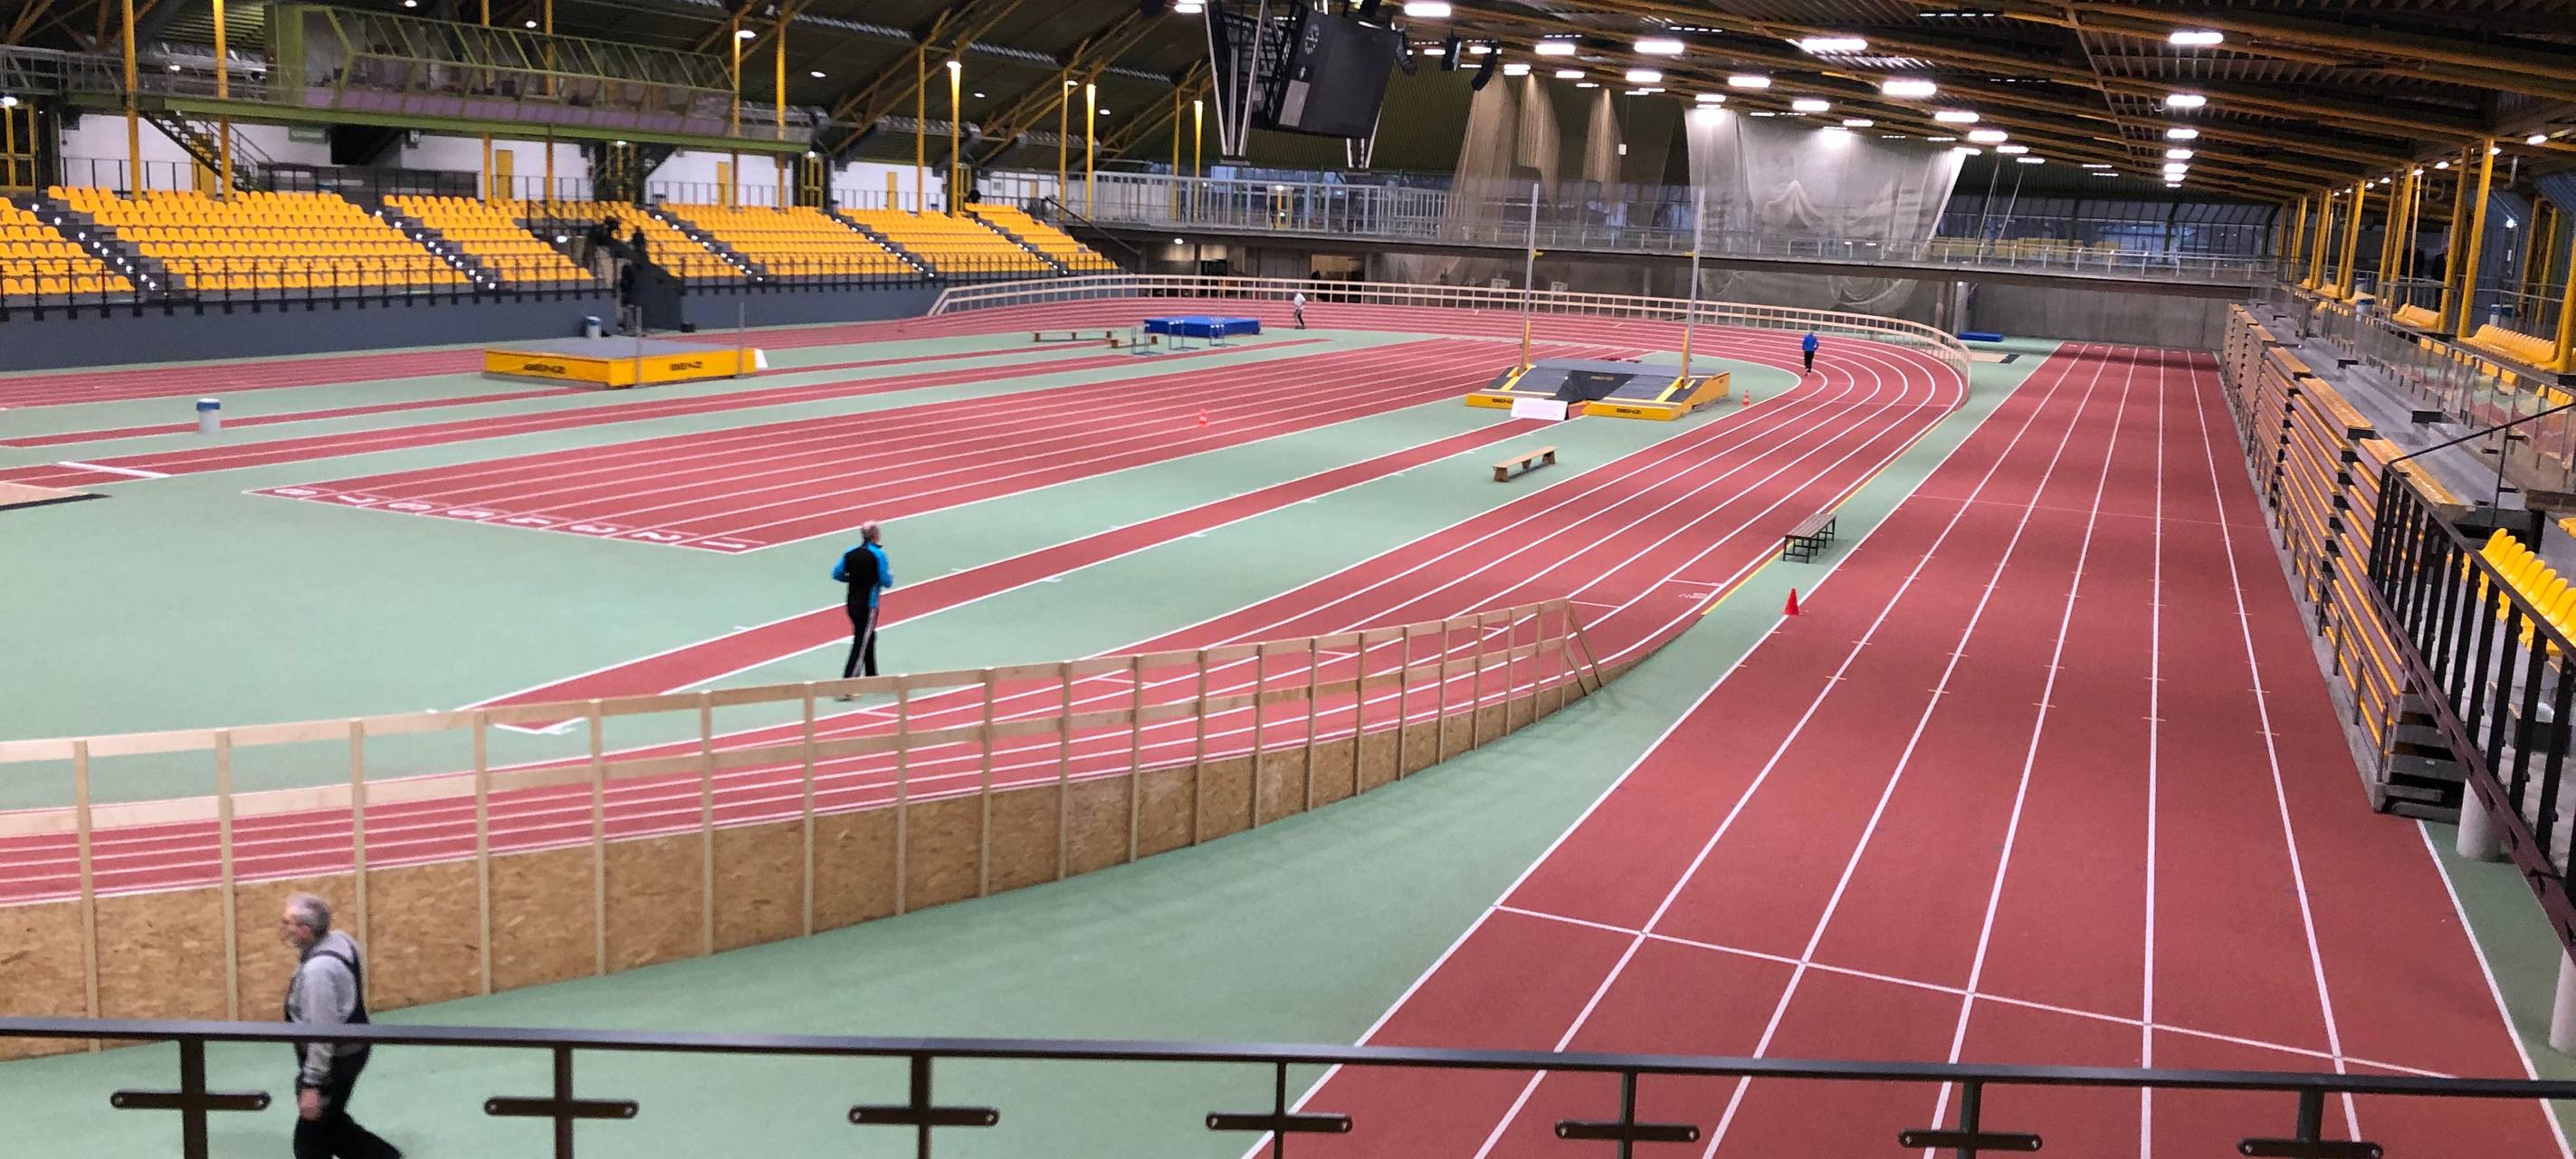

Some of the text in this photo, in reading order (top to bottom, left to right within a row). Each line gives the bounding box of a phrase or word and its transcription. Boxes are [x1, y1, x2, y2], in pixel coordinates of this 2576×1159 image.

[670, 361, 702, 370] BENZ
[338, 495, 377, 503] 7
[448, 510, 494, 518] 5
[570, 524, 617, 532] 3
[633, 532, 682, 541] 2
[702, 541, 746, 549] 1
